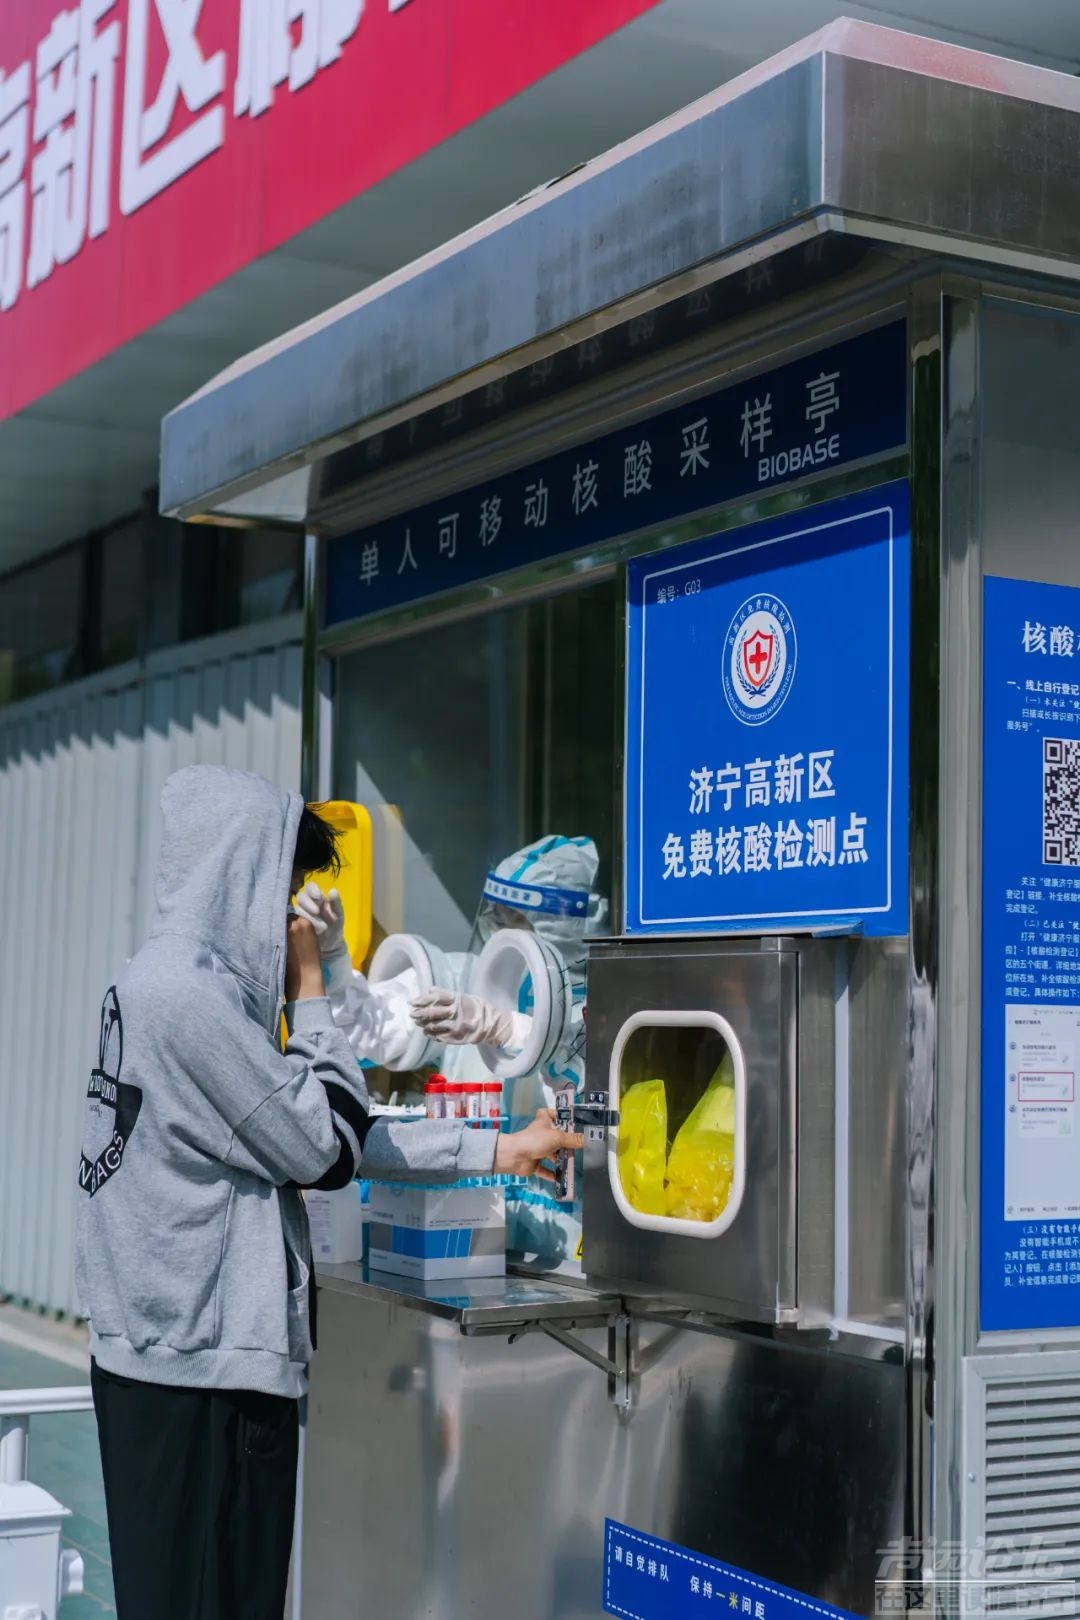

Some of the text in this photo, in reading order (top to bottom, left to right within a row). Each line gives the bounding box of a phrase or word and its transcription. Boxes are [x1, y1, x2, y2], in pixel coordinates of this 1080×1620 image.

[358, 370, 841, 588] 单人可移动核酸采样亭
[757, 433, 840, 482] BIOBASE
[1021, 620, 1080, 657] 核酸
[688, 749, 836, 815] 济宁高新区
[661, 812, 869, 881] 免费核酸检测点
[615, 1545, 766, 1620] 请自觉排队 保持一米间距
